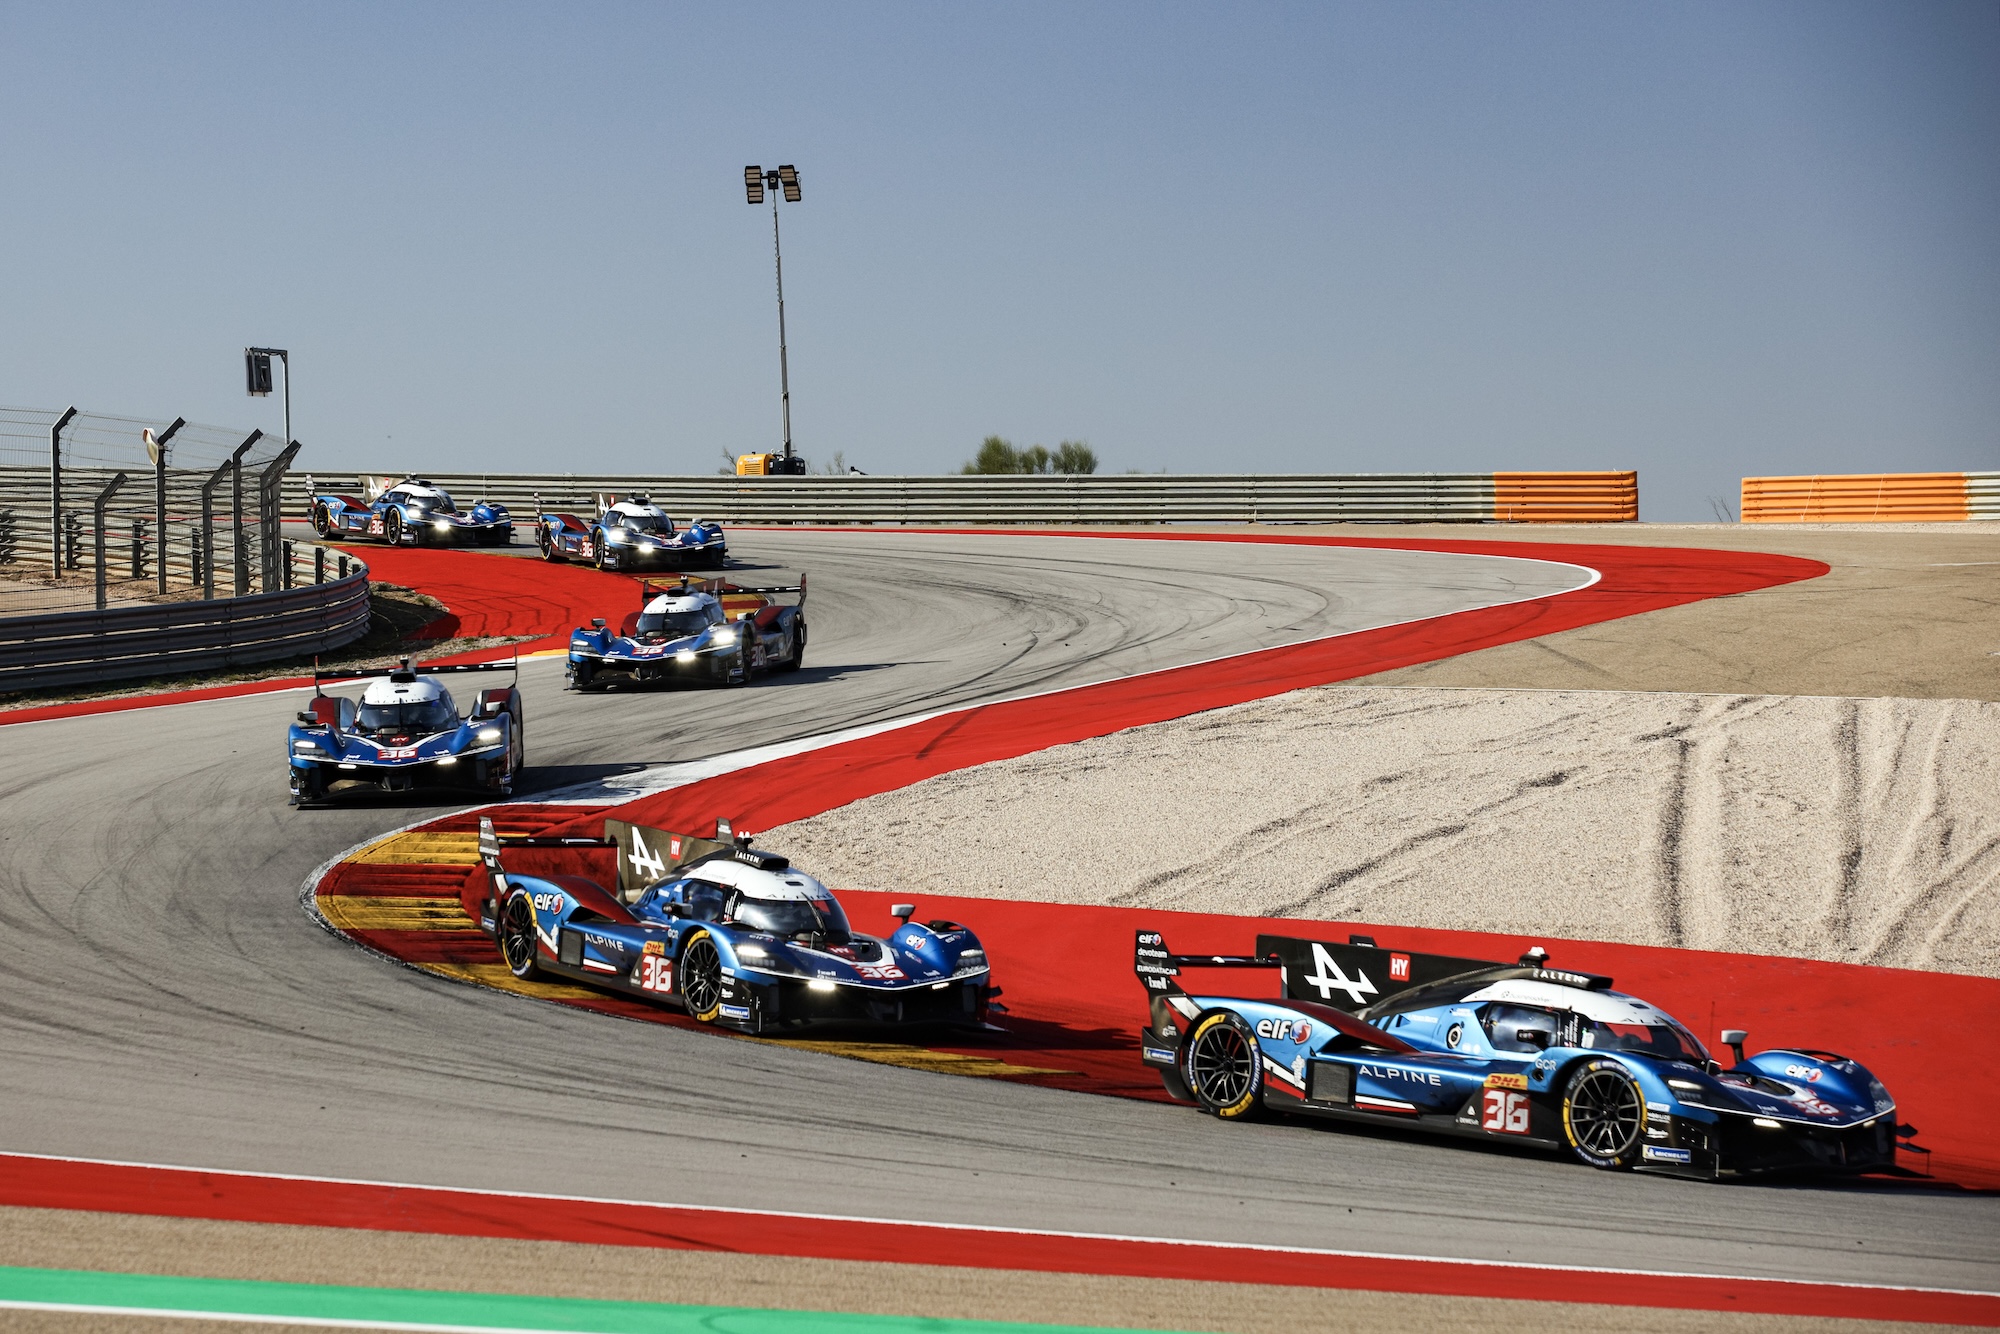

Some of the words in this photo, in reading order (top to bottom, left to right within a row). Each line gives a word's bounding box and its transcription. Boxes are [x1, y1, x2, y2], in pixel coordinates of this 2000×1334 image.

[371, 520, 384, 535] 36
[582, 541, 594, 557] 36
[380, 750, 416, 759] 36
[671, 839, 681, 855] HY
[738, 851, 760, 863] ALTEN
[534, 893, 553, 911] elf
[668, 928, 679, 939] GCR
[1138, 934, 1153, 944] elf
[585, 932, 624, 952] ALPINE
[646, 942, 662, 953] DHL
[1137, 947, 1168, 958] devoteam
[642, 955, 672, 992] 36
[1136, 965, 1178, 976] EURODATACAR
[1391, 958, 1409, 977] HY
[1540, 970, 1587, 983] ALTEN
[1256, 1019, 1292, 1040] elf
[1535, 1059, 1557, 1071] GCR
[1359, 1065, 1442, 1087] ALPINE
[1490, 1075, 1522, 1087] DHL
[1483, 1090, 1530, 1132] 36
[1655, 1150, 1690, 1159] MICHELIN
